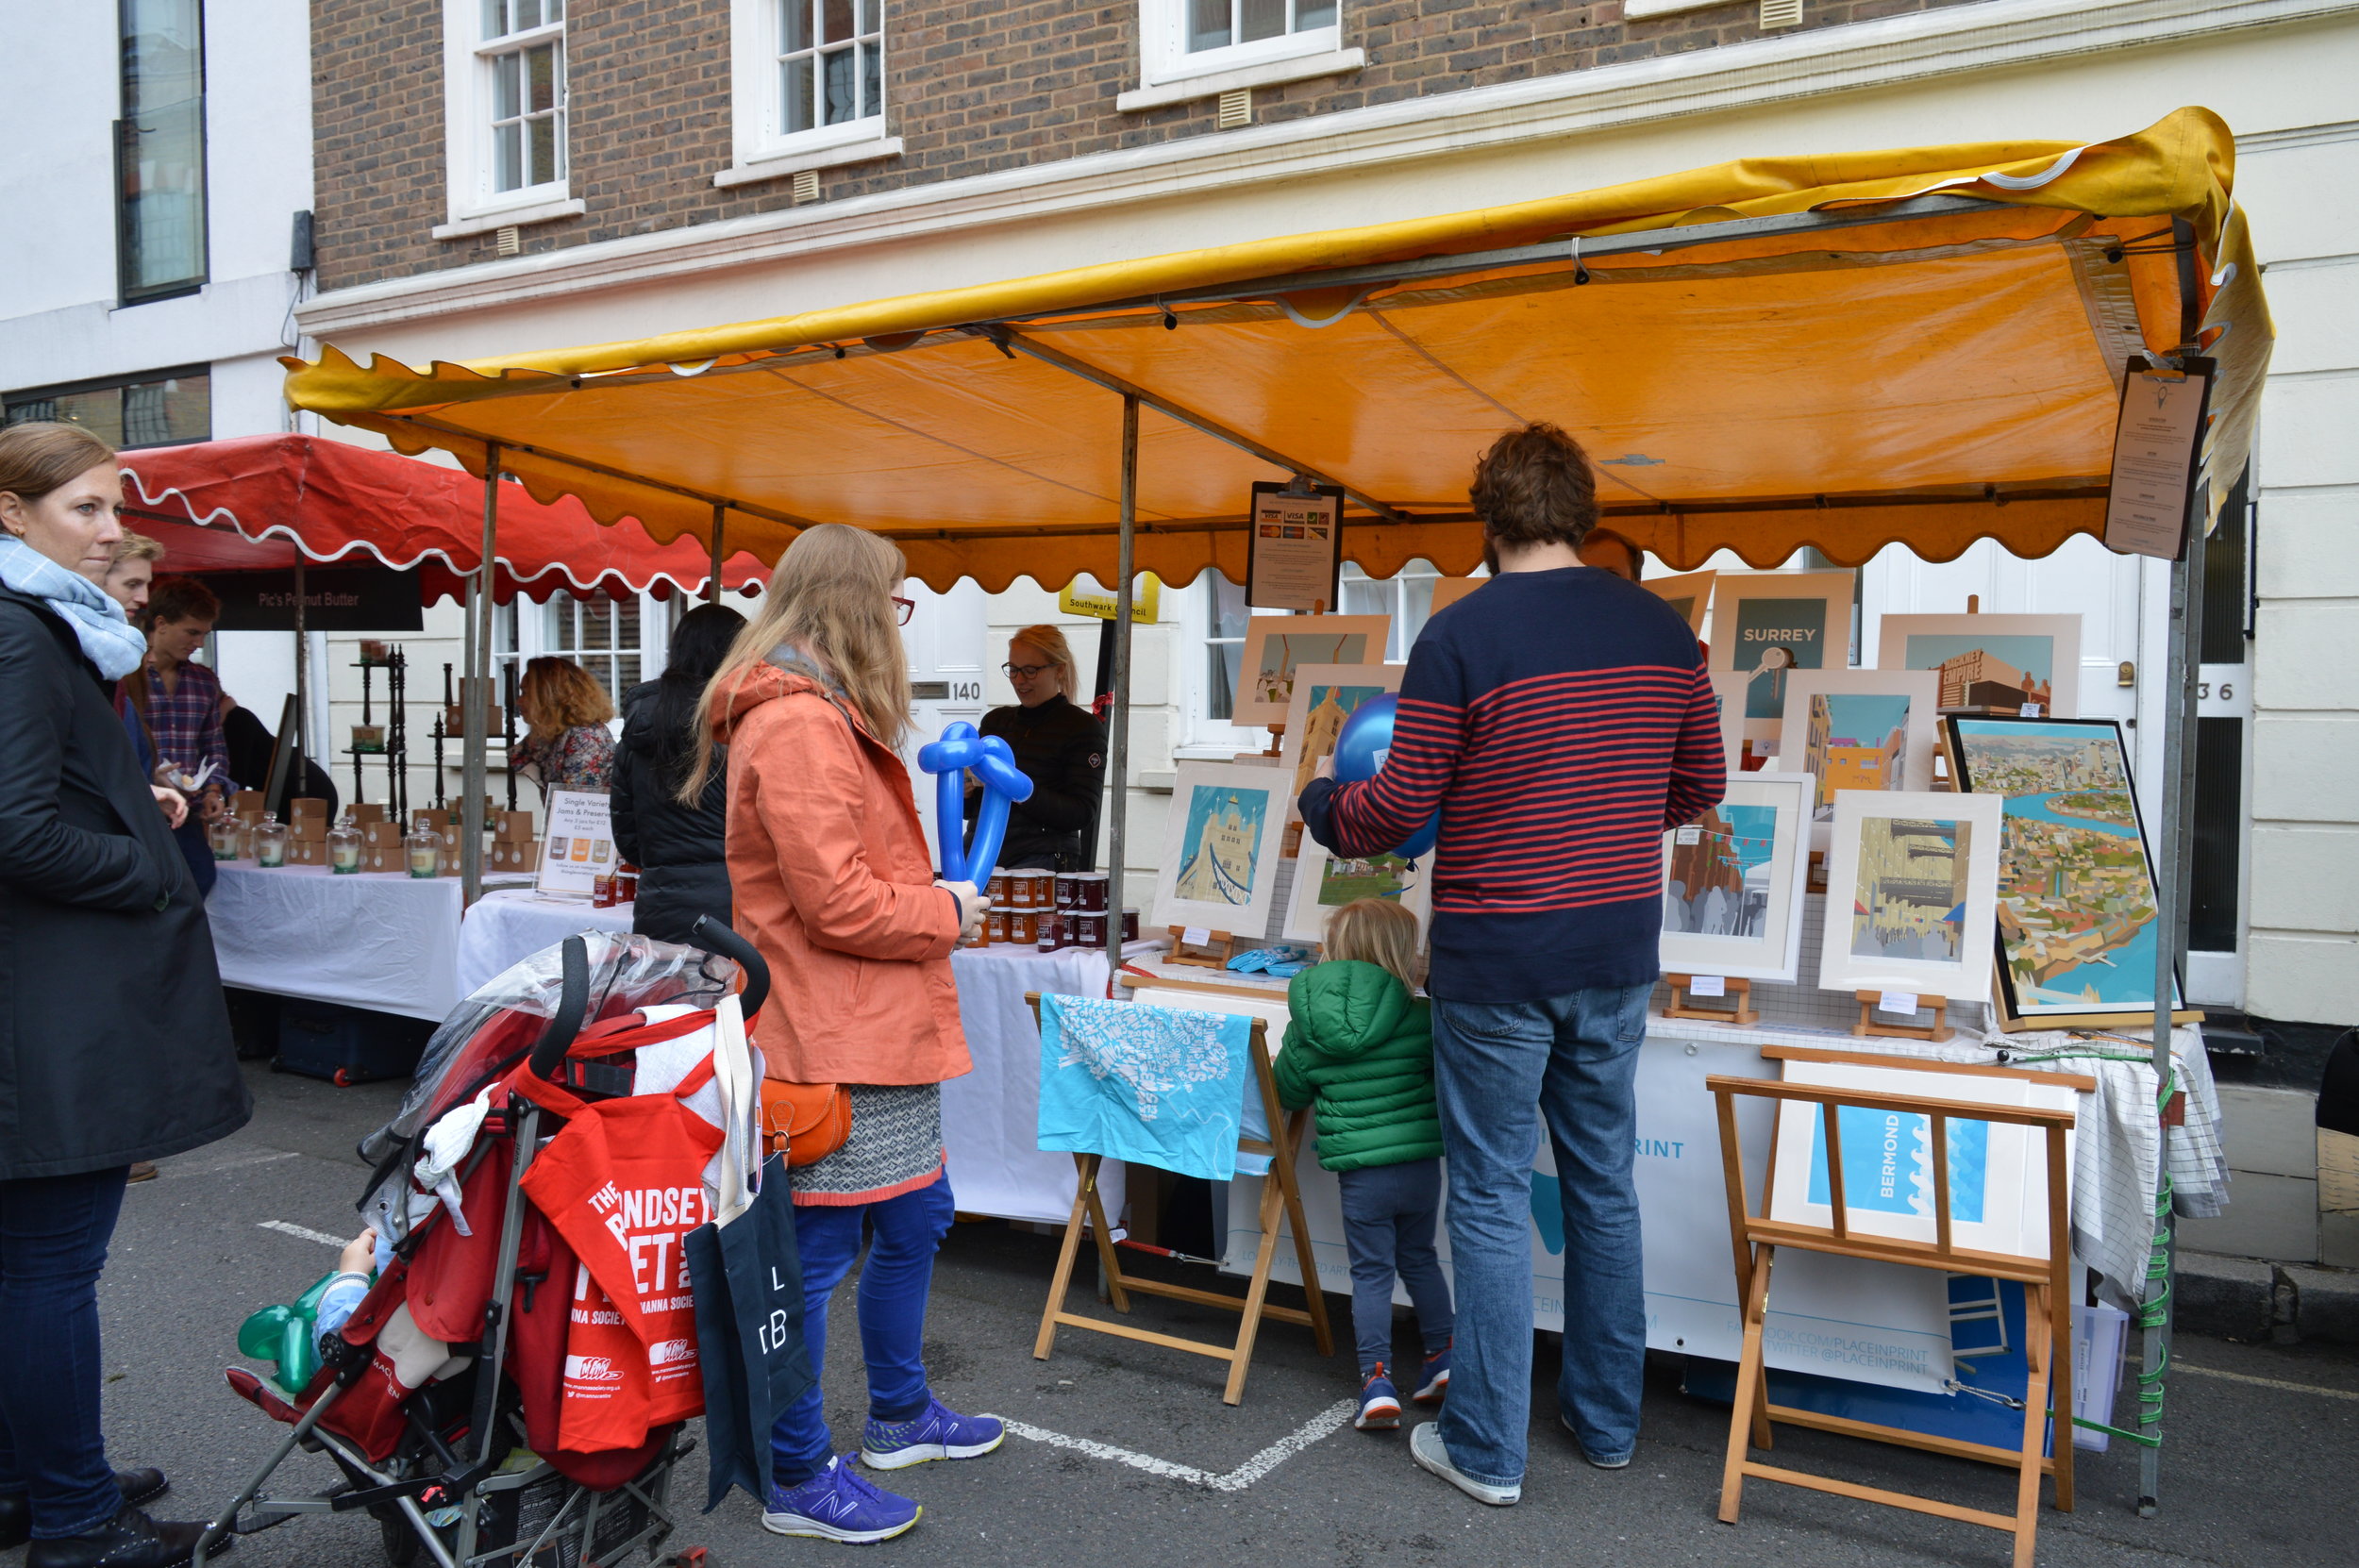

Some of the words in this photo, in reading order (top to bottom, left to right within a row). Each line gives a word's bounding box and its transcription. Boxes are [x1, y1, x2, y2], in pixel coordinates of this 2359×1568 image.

[285, 592, 323, 607] Penut
[325, 592, 360, 607] Butter
[1070, 598, 1113, 611] Southwark
[1115, 605, 1146, 616] Cncil
[1744, 628, 1816, 642] SURREY
[1944, 661, 1982, 685] EMPIRE
[953, 682, 979, 701] 140
[564, 798, 585, 808] Single
[1634, 1138, 1684, 1159] RINT
[1881, 1114, 1899, 1198] BERMOND
[587, 1179, 618, 1214] THE
[1765, 1339, 1818, 1358] TWITTER
[1821, 1348, 1929, 1375] @PLACEINPRINT
